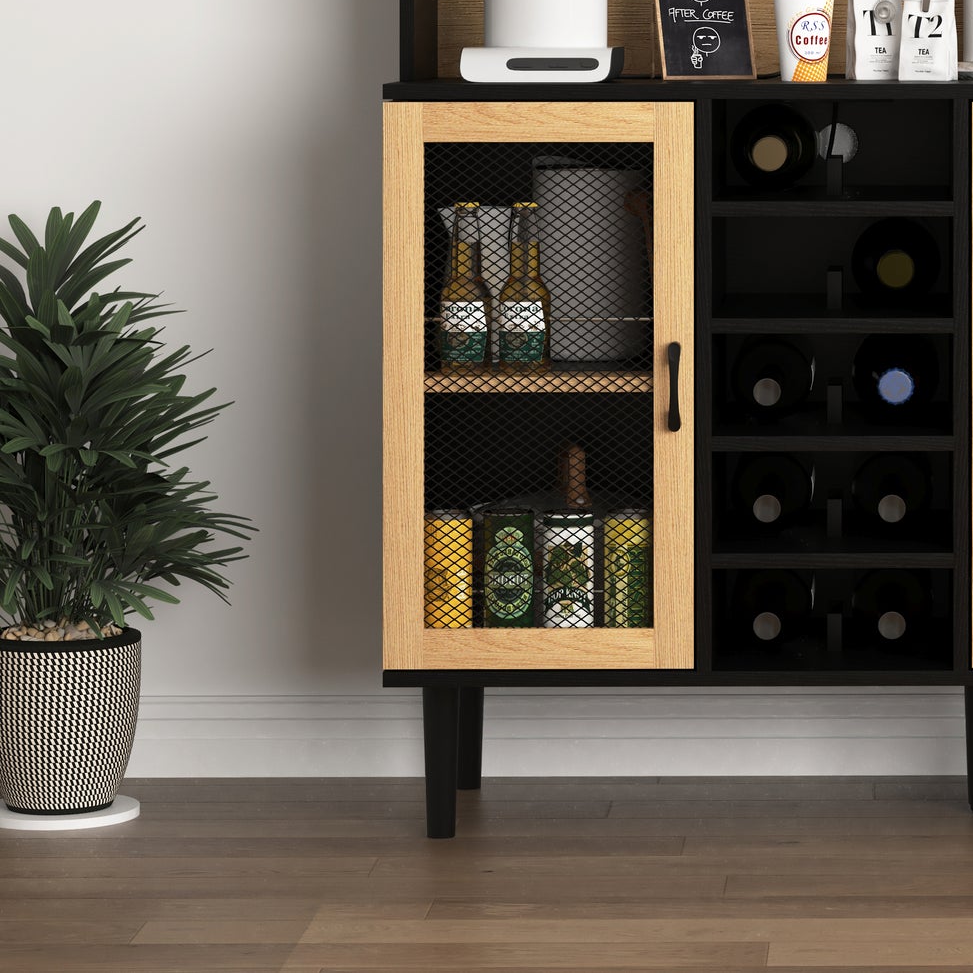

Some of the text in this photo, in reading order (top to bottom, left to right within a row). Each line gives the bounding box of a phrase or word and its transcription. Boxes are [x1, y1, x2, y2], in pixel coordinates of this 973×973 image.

[668, 8, 734, 23] AFTER COFFEE
[908, 14, 942, 38] T2
[796, 35, 828, 45] Coffee
